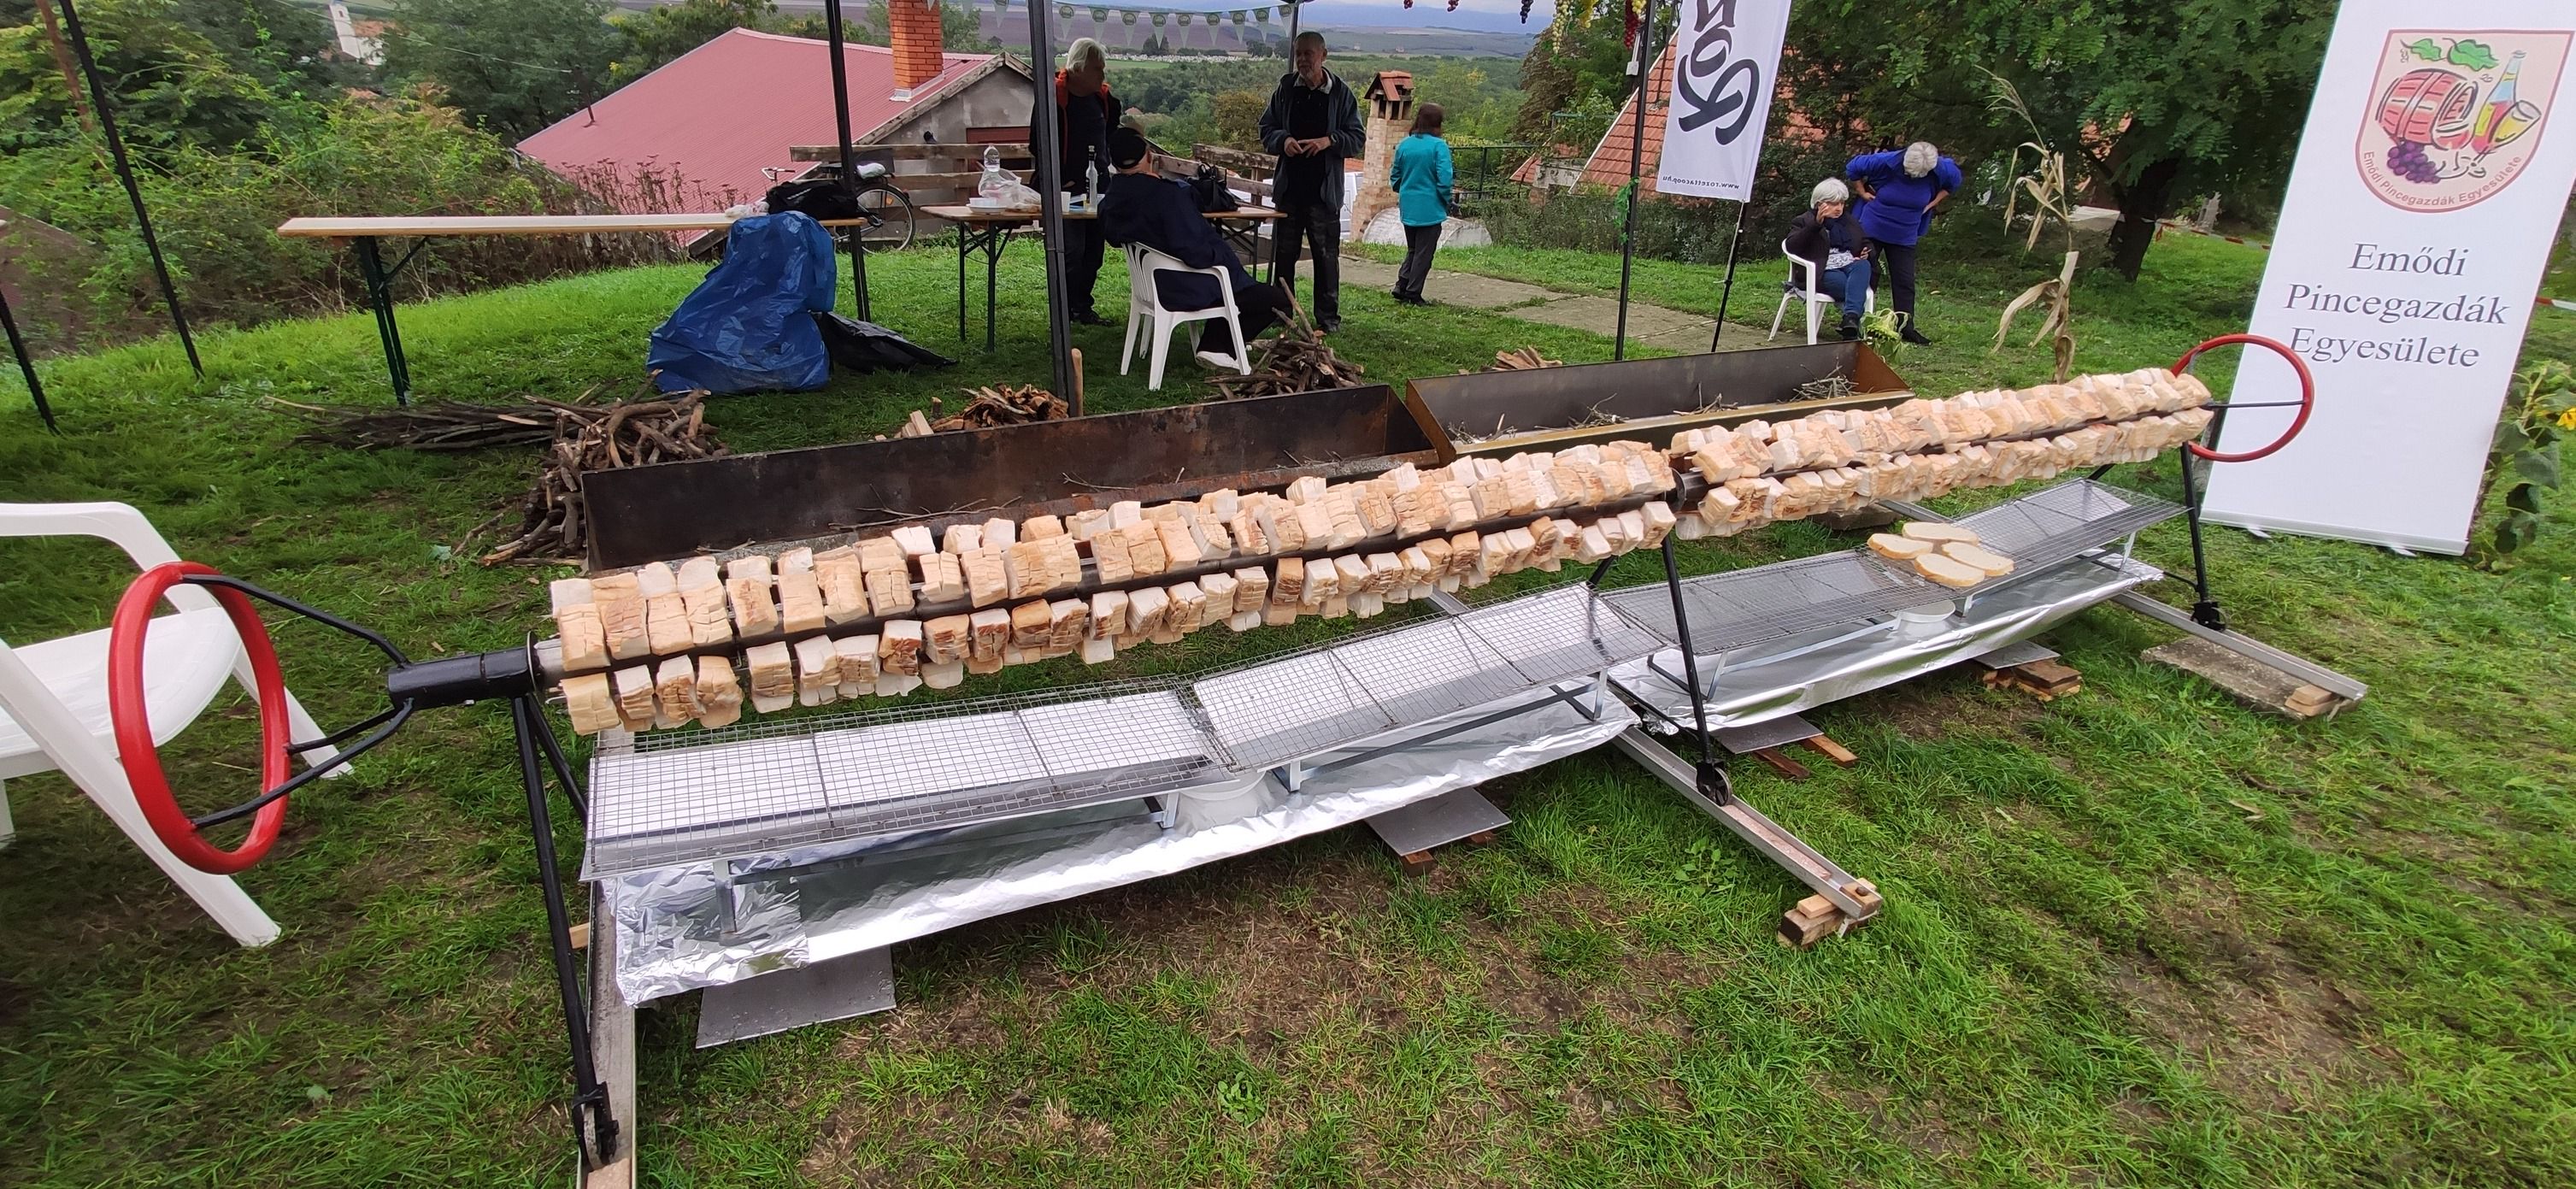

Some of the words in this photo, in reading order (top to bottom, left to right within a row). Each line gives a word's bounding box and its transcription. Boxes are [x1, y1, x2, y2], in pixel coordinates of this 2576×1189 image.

[2363, 151, 2382, 183] Emődi
[2379, 182, 2455, 206] Pincegazdák
[2459, 156, 2521, 203] Egyesülete
[2347, 243, 2469, 276] Emődi
[2283, 284, 2511, 324] Pincegazdák
[2291, 327, 2479, 367] Egyesülete
